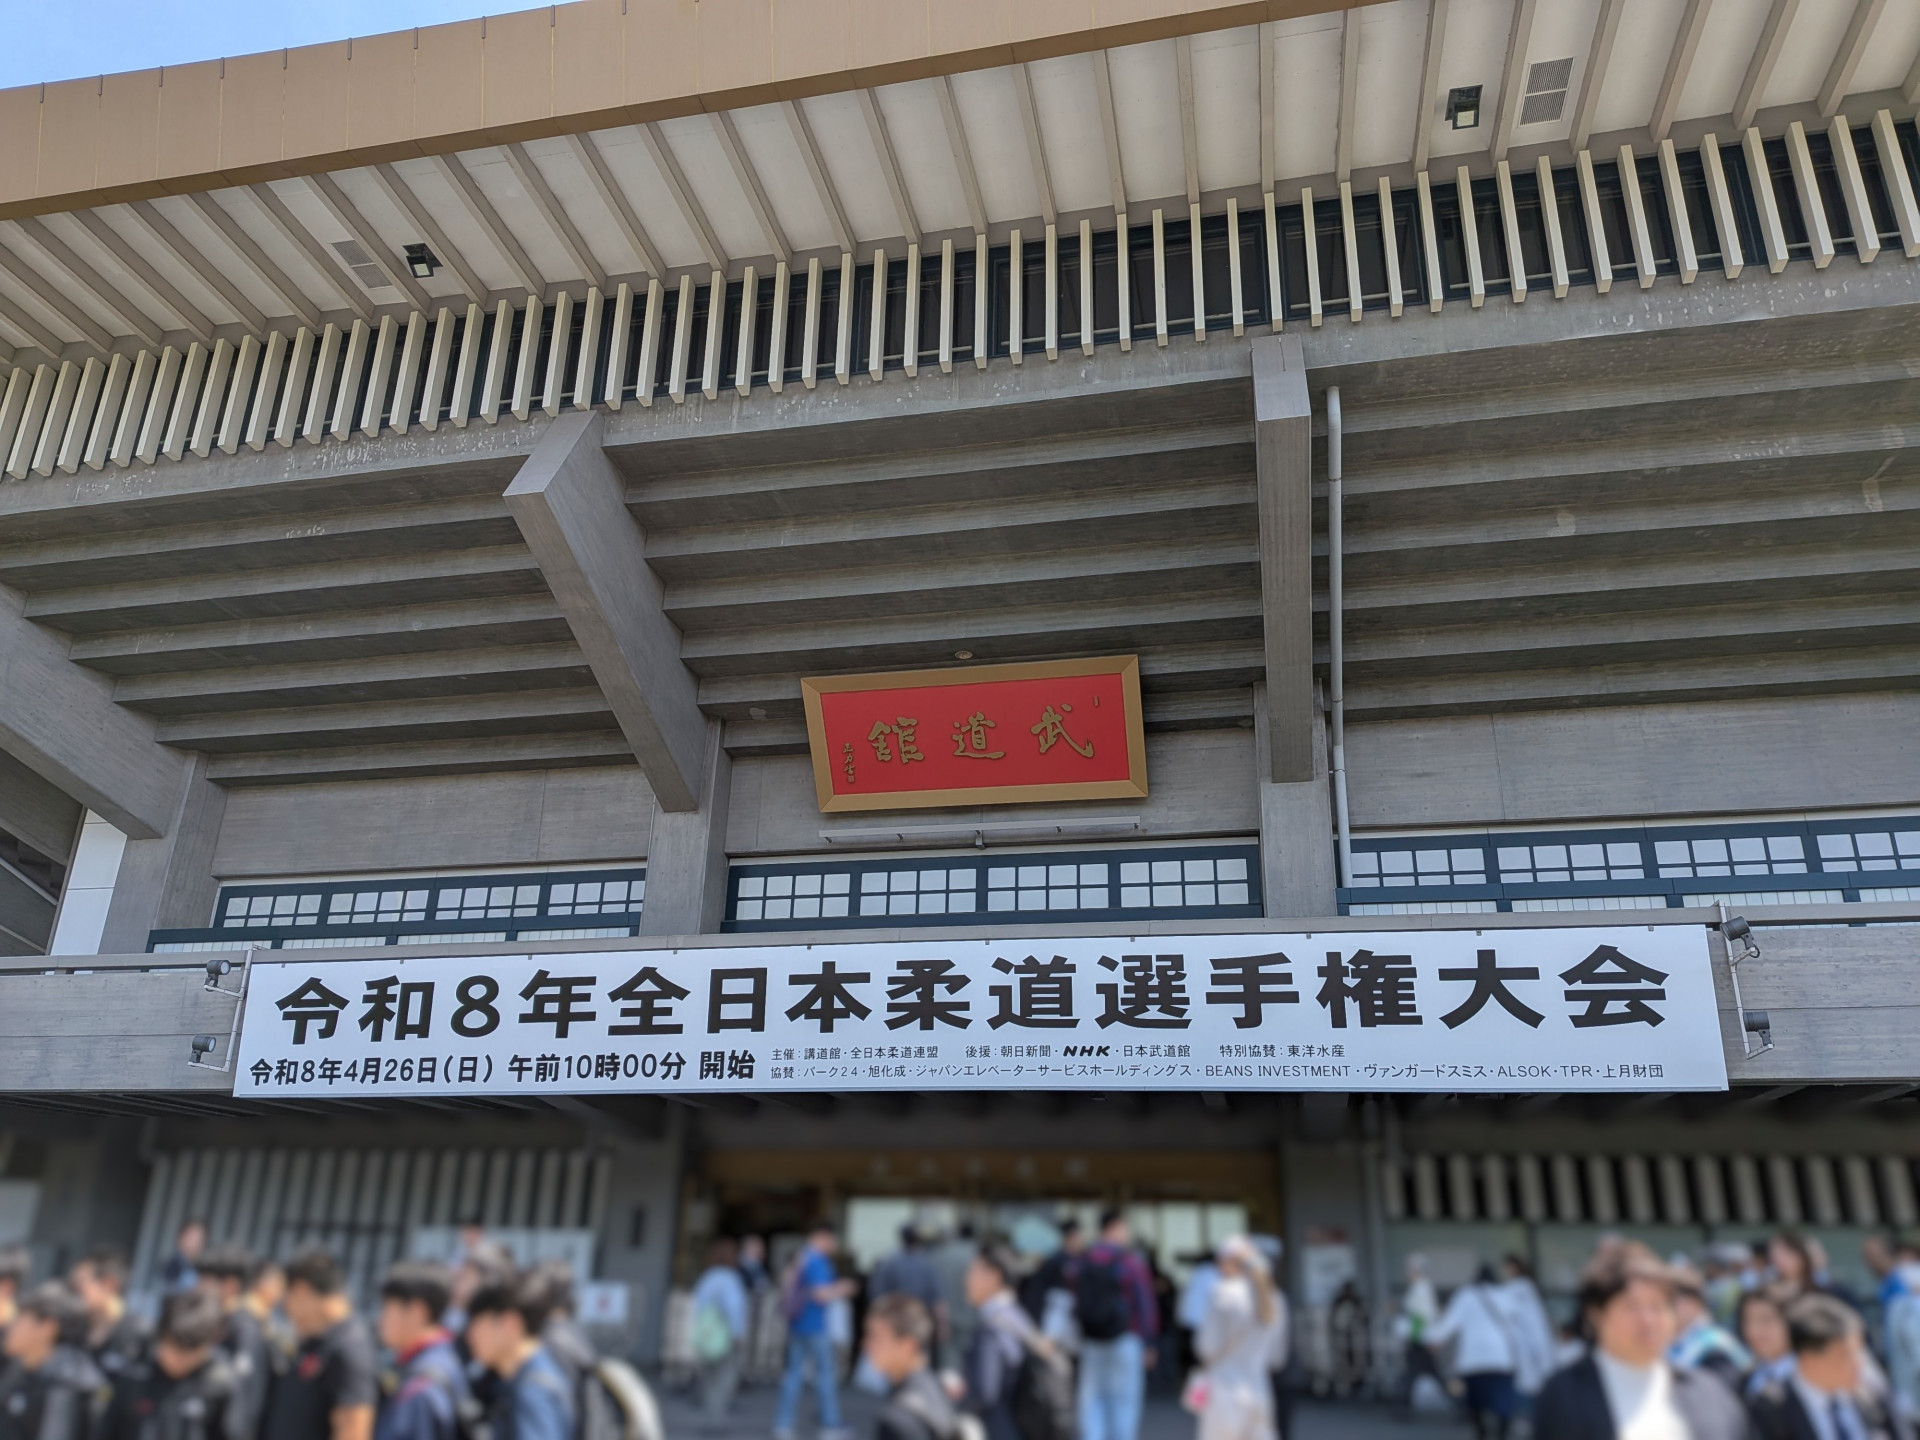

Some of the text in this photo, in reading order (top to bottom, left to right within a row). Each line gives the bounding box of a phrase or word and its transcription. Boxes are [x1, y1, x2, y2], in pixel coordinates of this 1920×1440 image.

[867, 702, 1095, 765] 武道館
[274, 944, 1670, 1045] 令和8年全日本柔道選手権大会
[249, 1049, 756, 1086] 令和8年4月26日(日) 午前10時00分 開始
